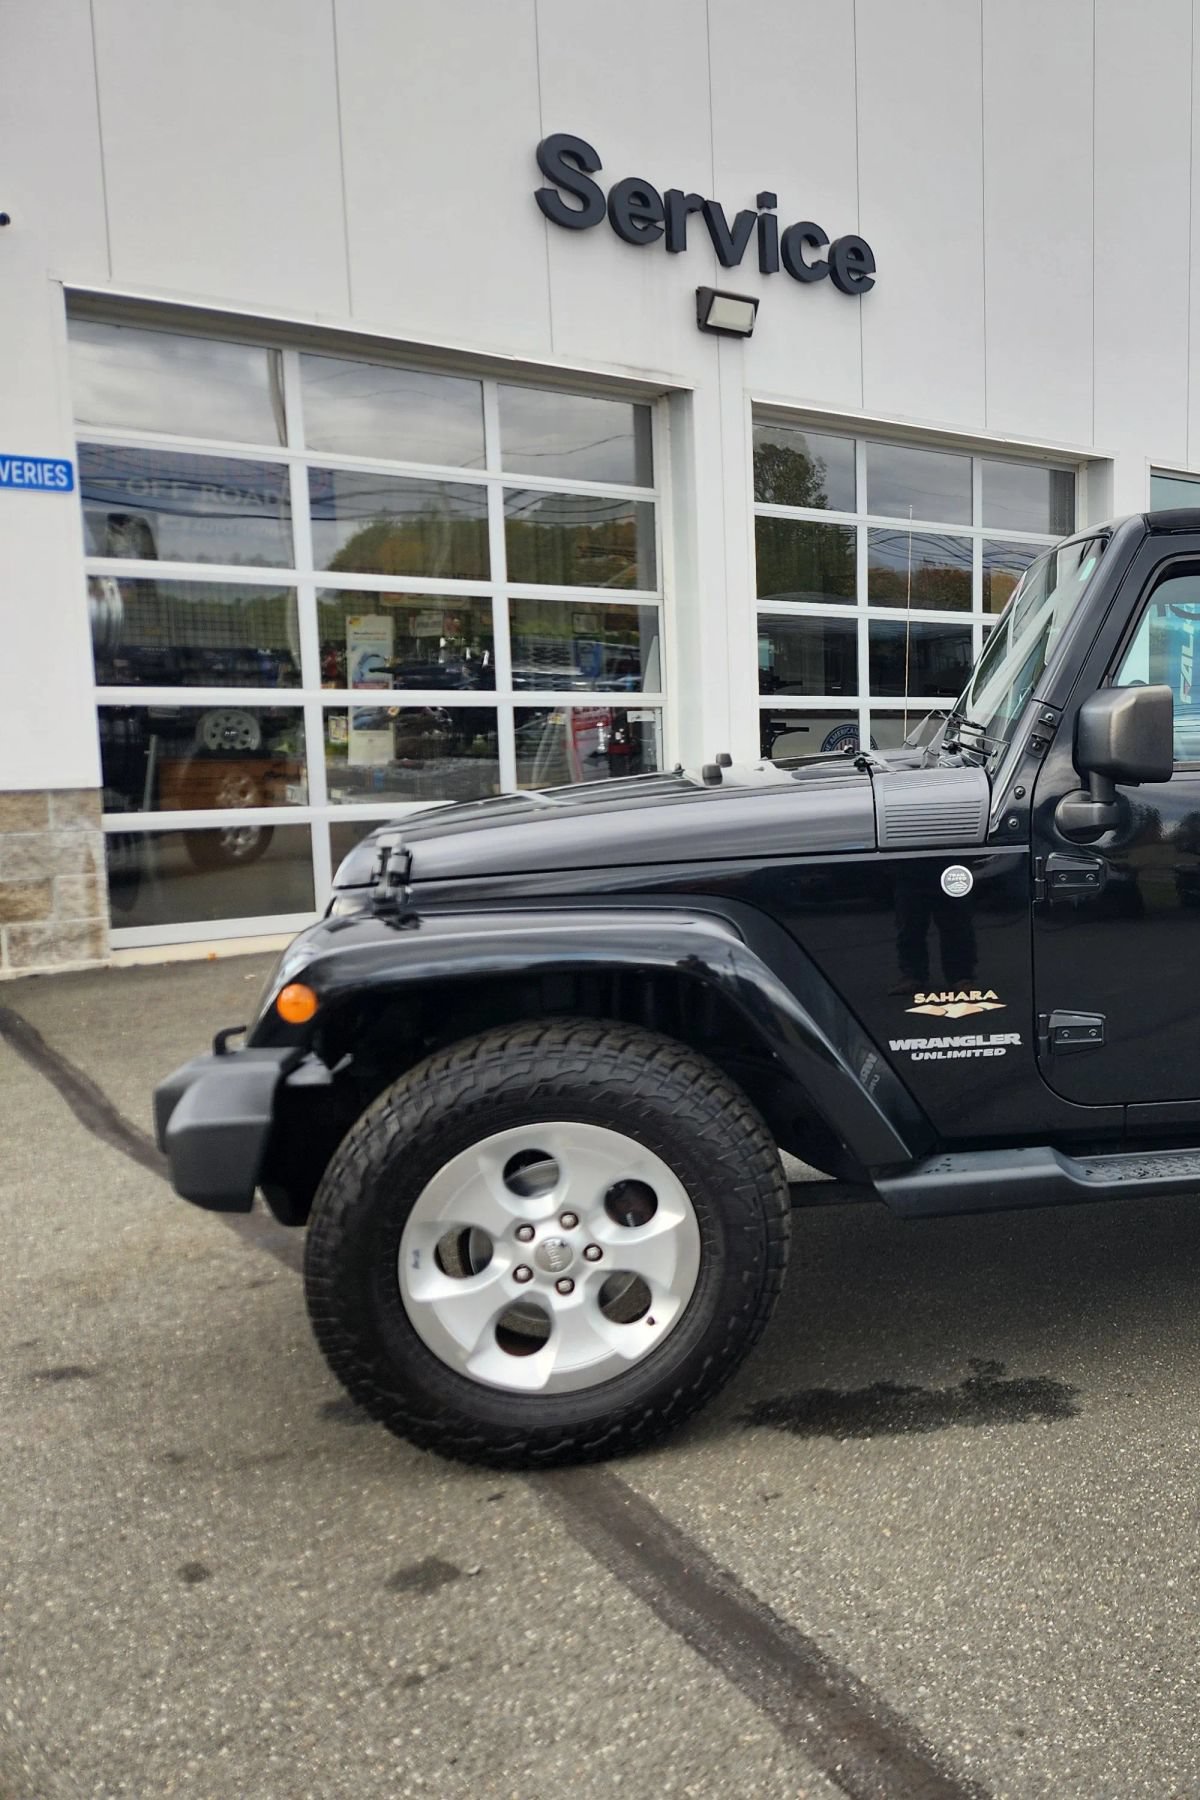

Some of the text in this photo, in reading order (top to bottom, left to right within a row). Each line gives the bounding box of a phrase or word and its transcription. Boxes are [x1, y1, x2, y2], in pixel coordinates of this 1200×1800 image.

[534, 132, 876, 295] Service
[0, 459, 69, 487] VERIES
[914, 990, 999, 1004] SAHARA
[889, 1033, 1022, 1051] WRANGLER
[911, 1048, 1006, 1061] UNLIMITED
